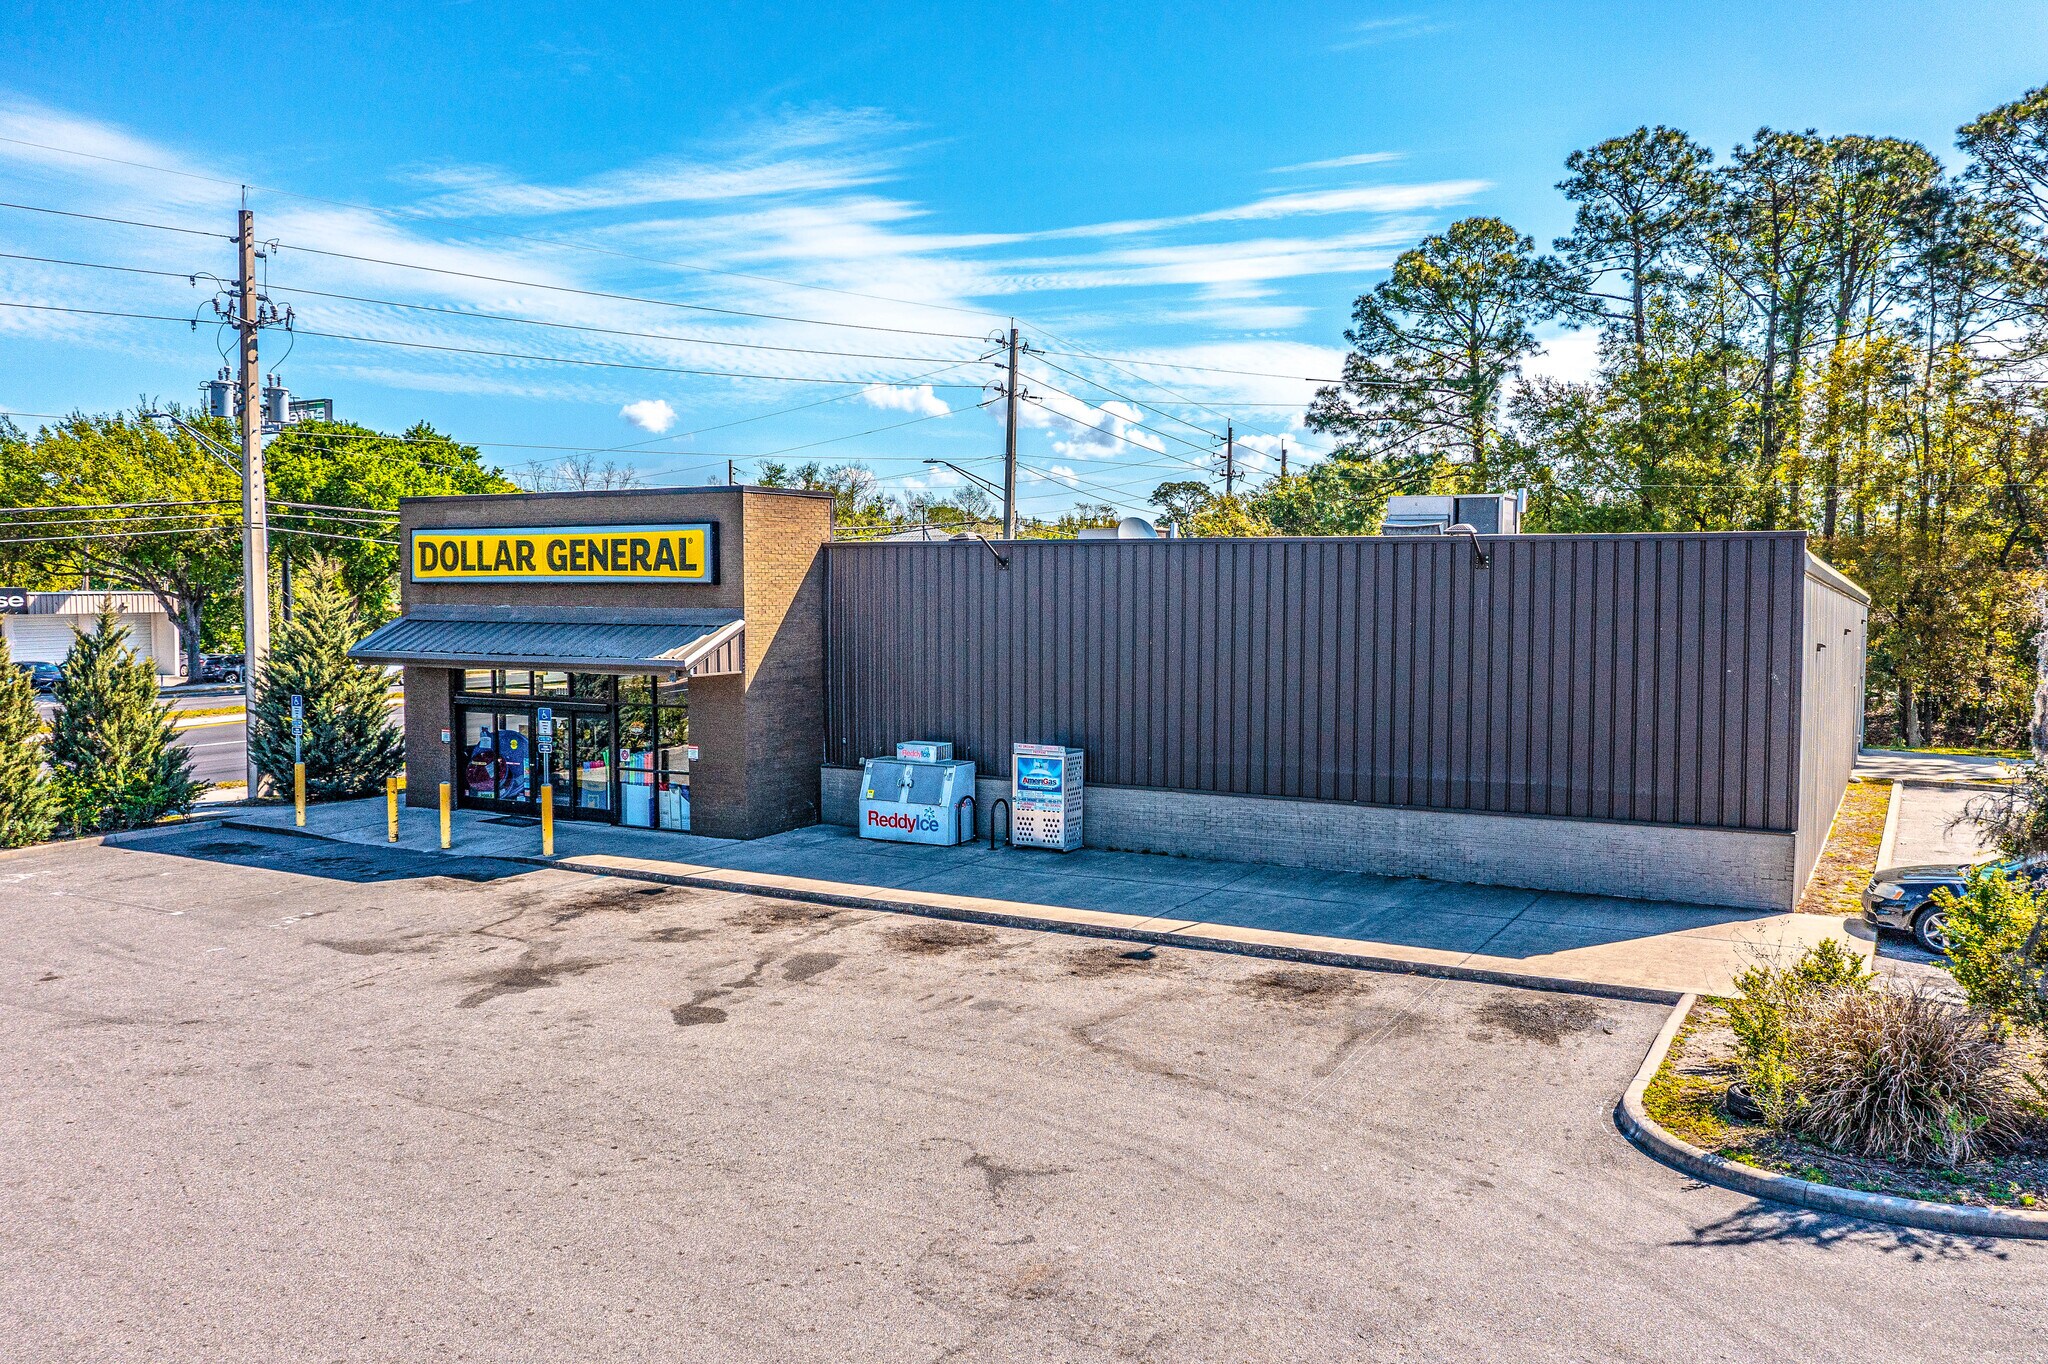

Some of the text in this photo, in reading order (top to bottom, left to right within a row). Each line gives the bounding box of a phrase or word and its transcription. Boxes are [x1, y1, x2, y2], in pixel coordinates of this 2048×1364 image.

[418, 537, 697, 573] DOLLAR GENERAL
[1022, 777, 1057, 786] AmeriGas
[867, 810, 939, 833] ReddyIce
